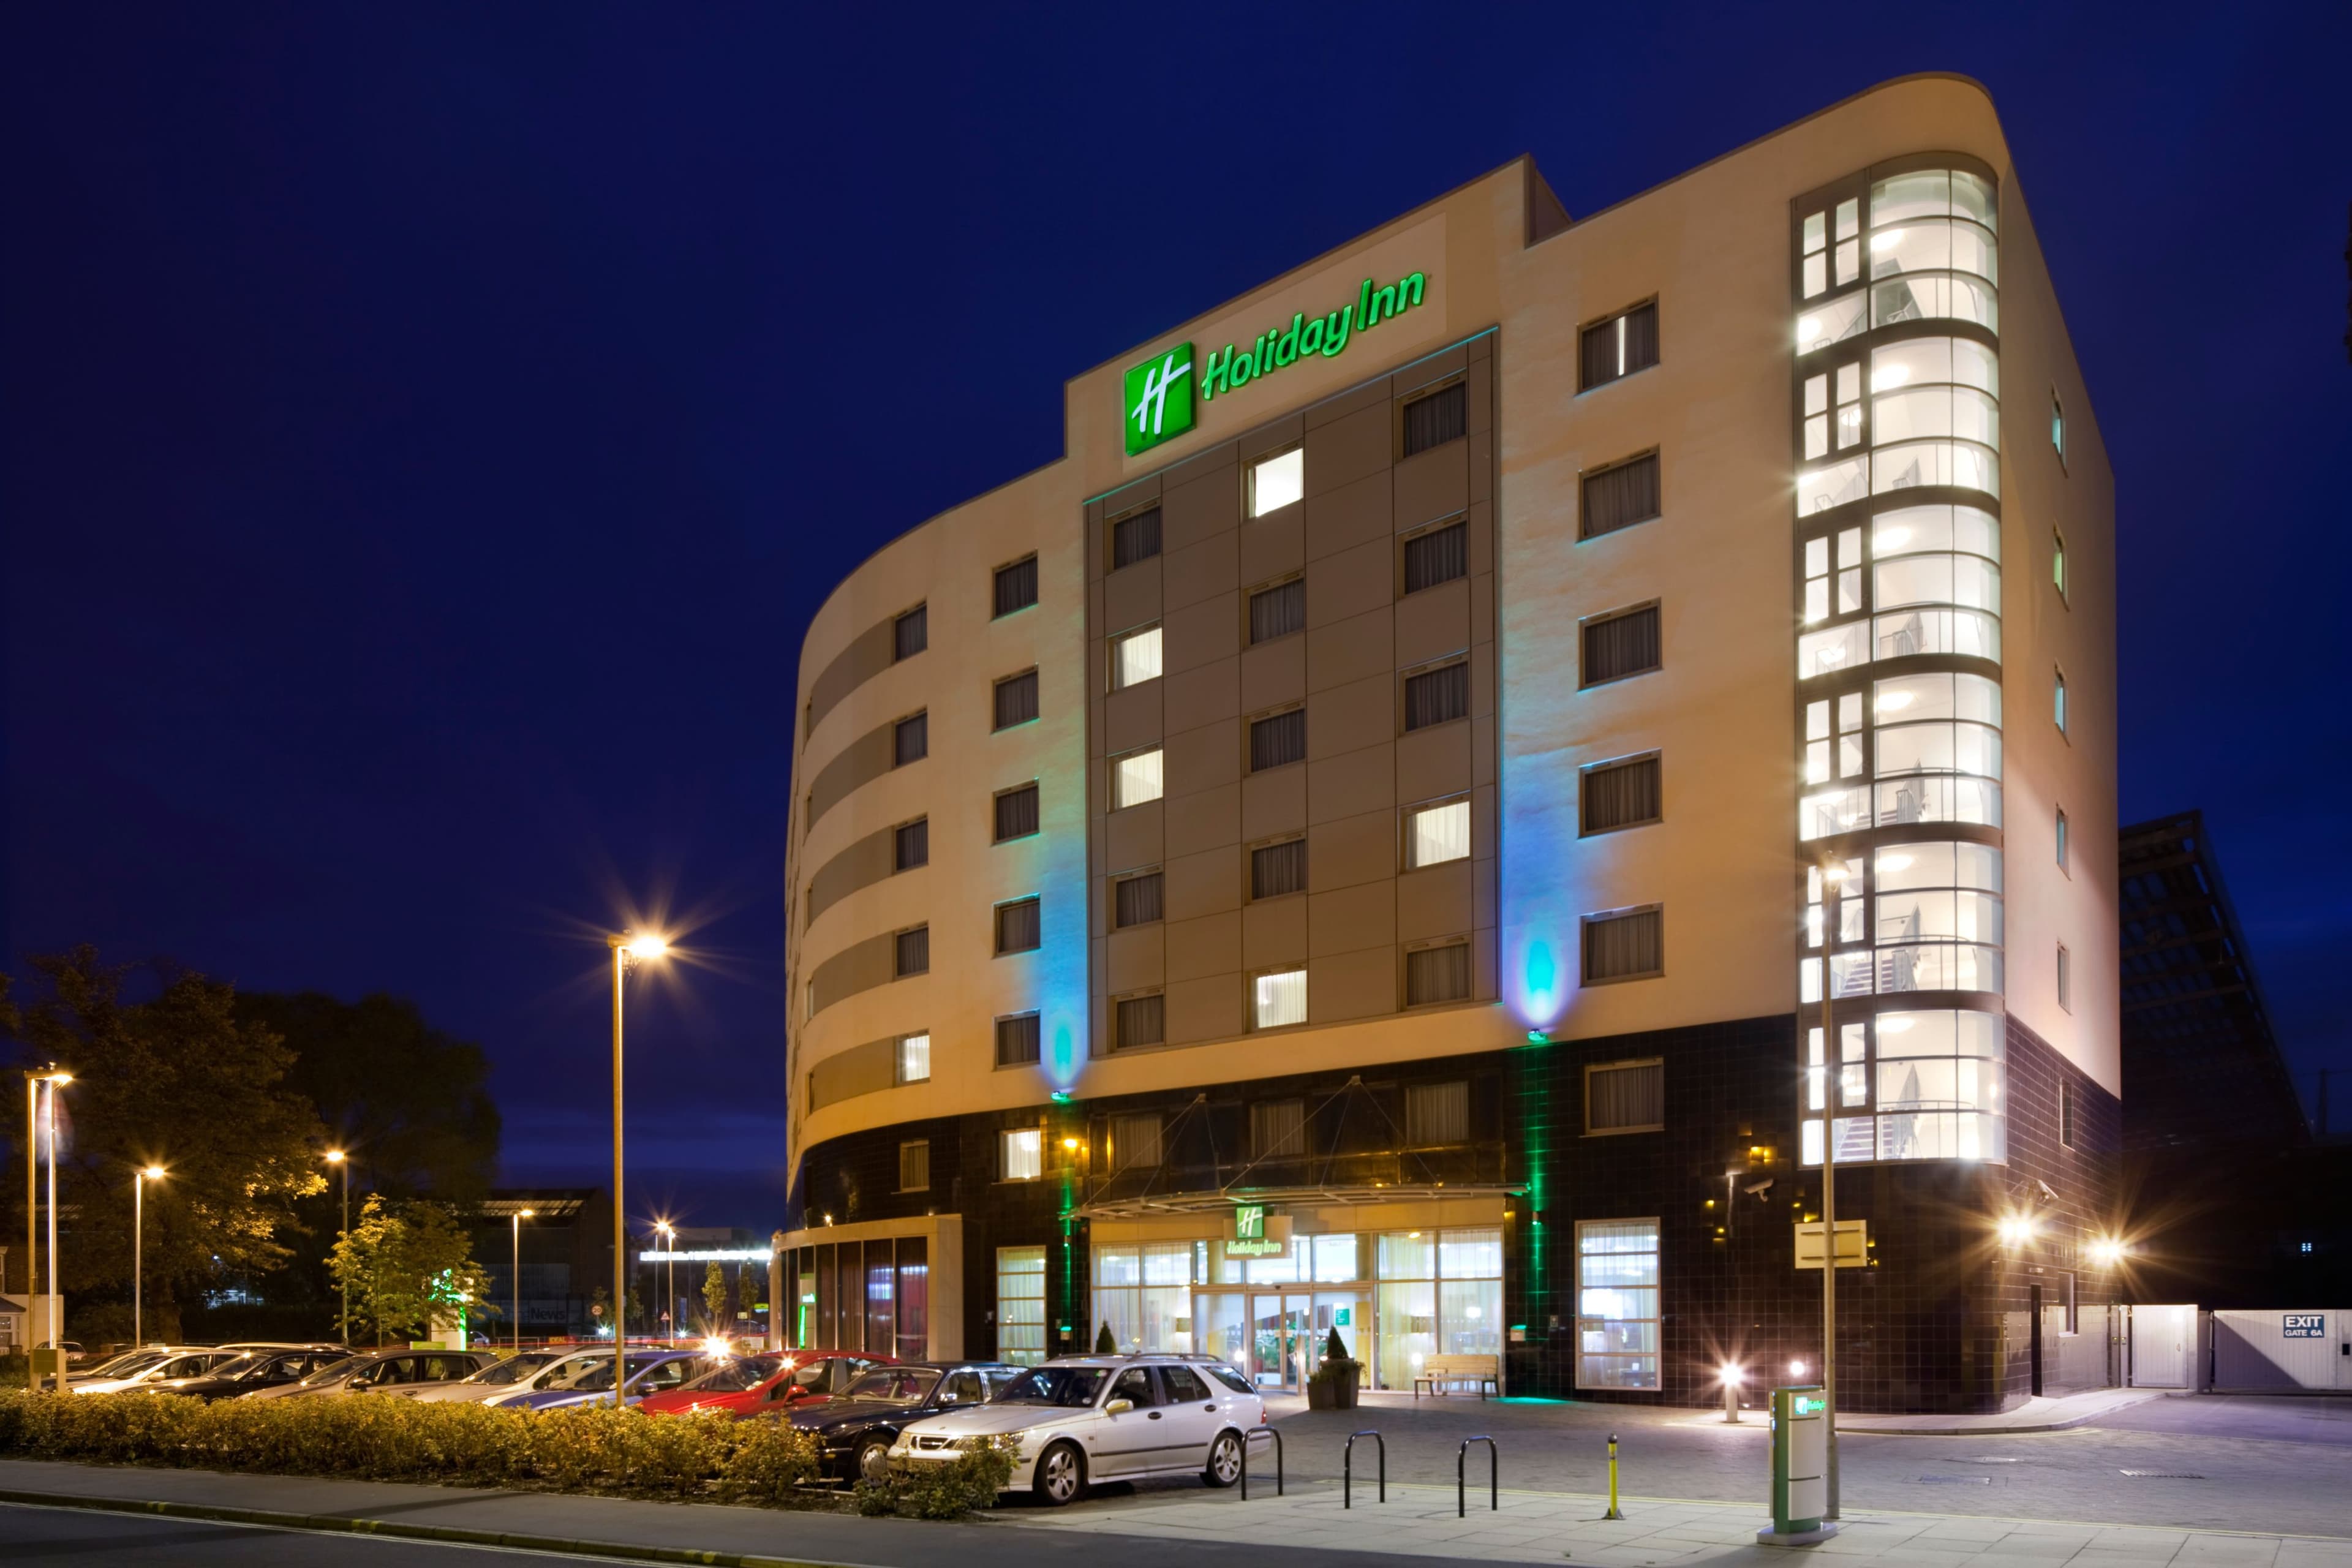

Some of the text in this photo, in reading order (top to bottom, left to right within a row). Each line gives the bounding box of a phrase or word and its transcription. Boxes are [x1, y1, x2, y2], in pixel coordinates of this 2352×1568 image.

[1201, 271, 1426, 401] Holiday Inn
[1227, 1239, 1281, 1256] Holiday Inn
[531, 1308, 565, 1320] News
[2286, 1316, 2321, 1327] EXIT
